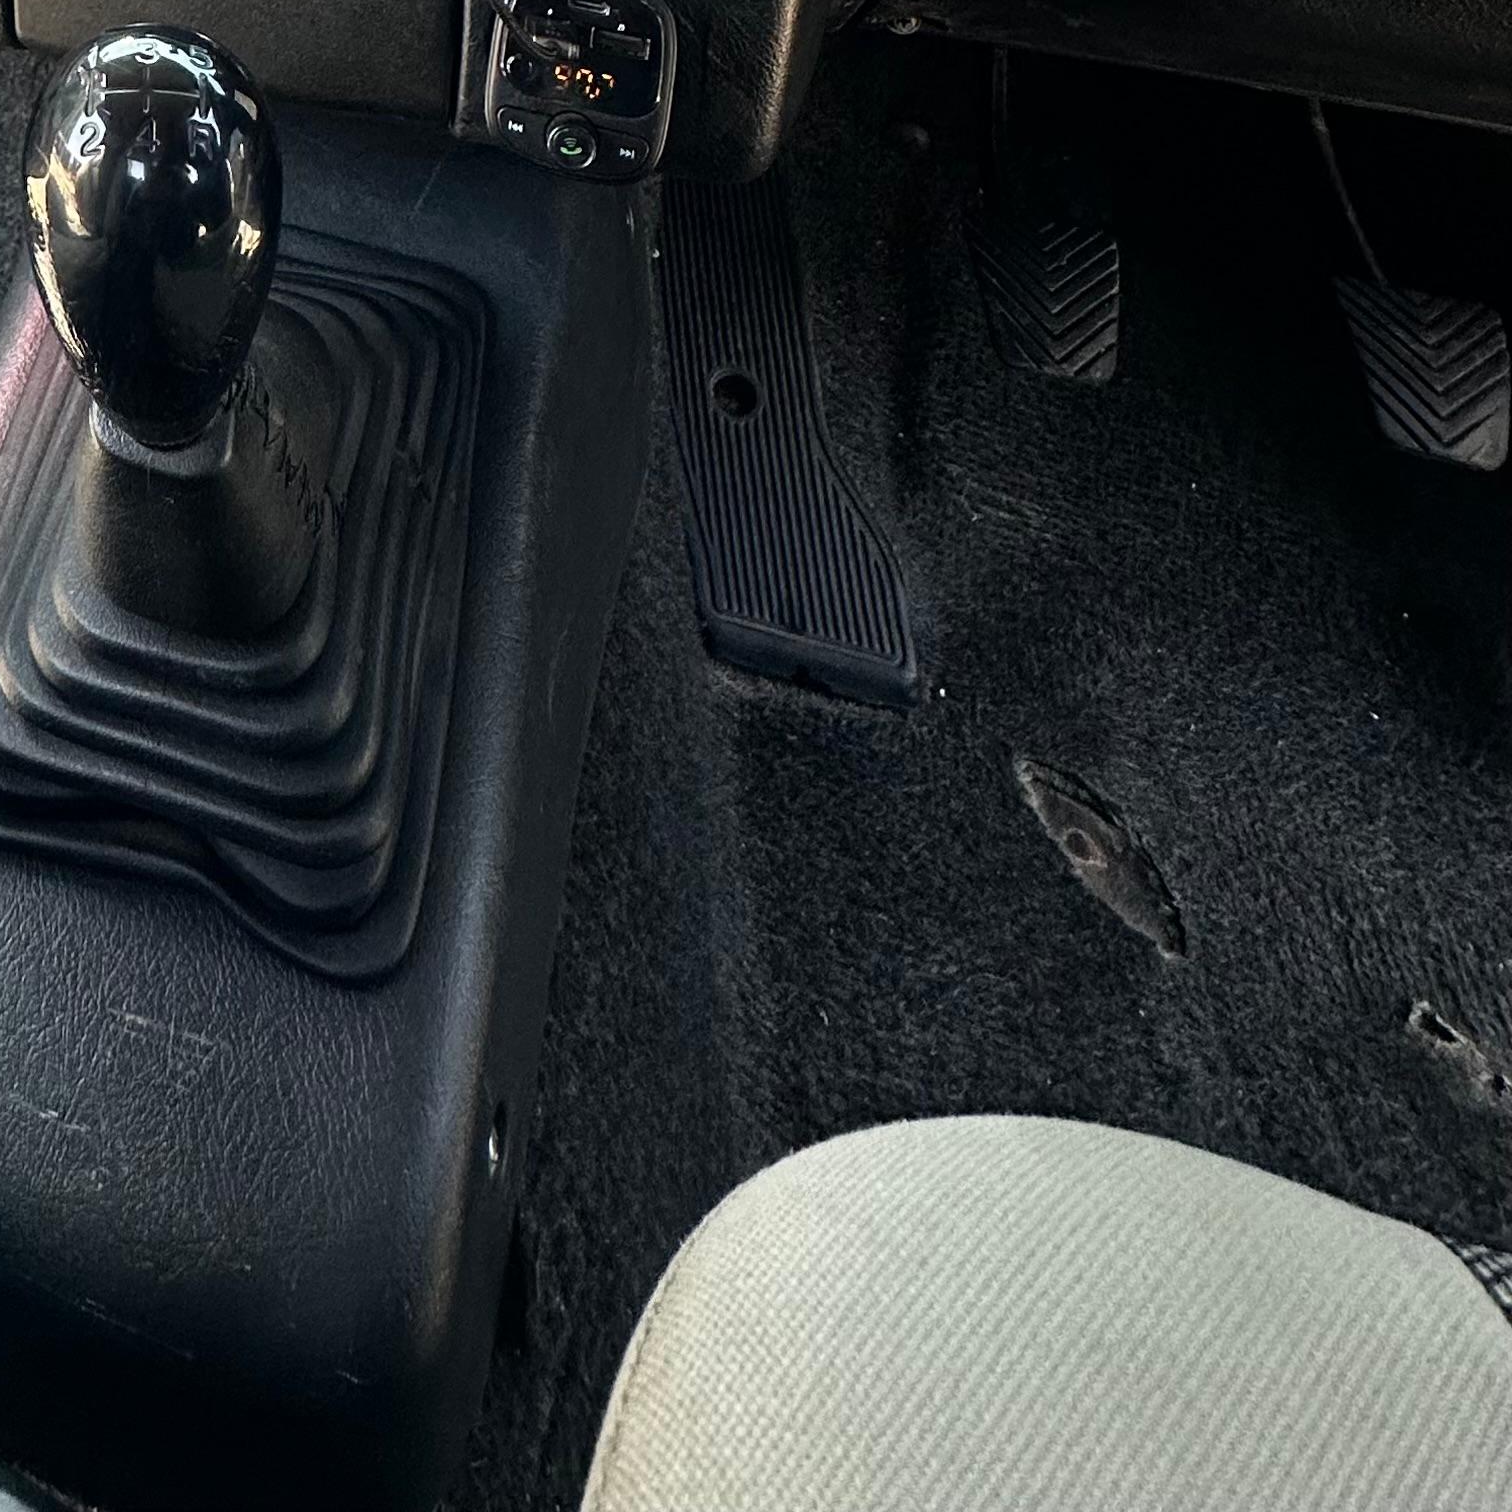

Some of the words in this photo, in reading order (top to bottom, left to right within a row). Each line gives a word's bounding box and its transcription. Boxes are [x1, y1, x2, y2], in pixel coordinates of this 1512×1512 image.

[134, 43, 161, 65] 3
[189, 47, 215, 70] 5
[80, 122, 105, 158] 2
[137, 117, 161, 154] 4
[188, 119, 215, 162] R
